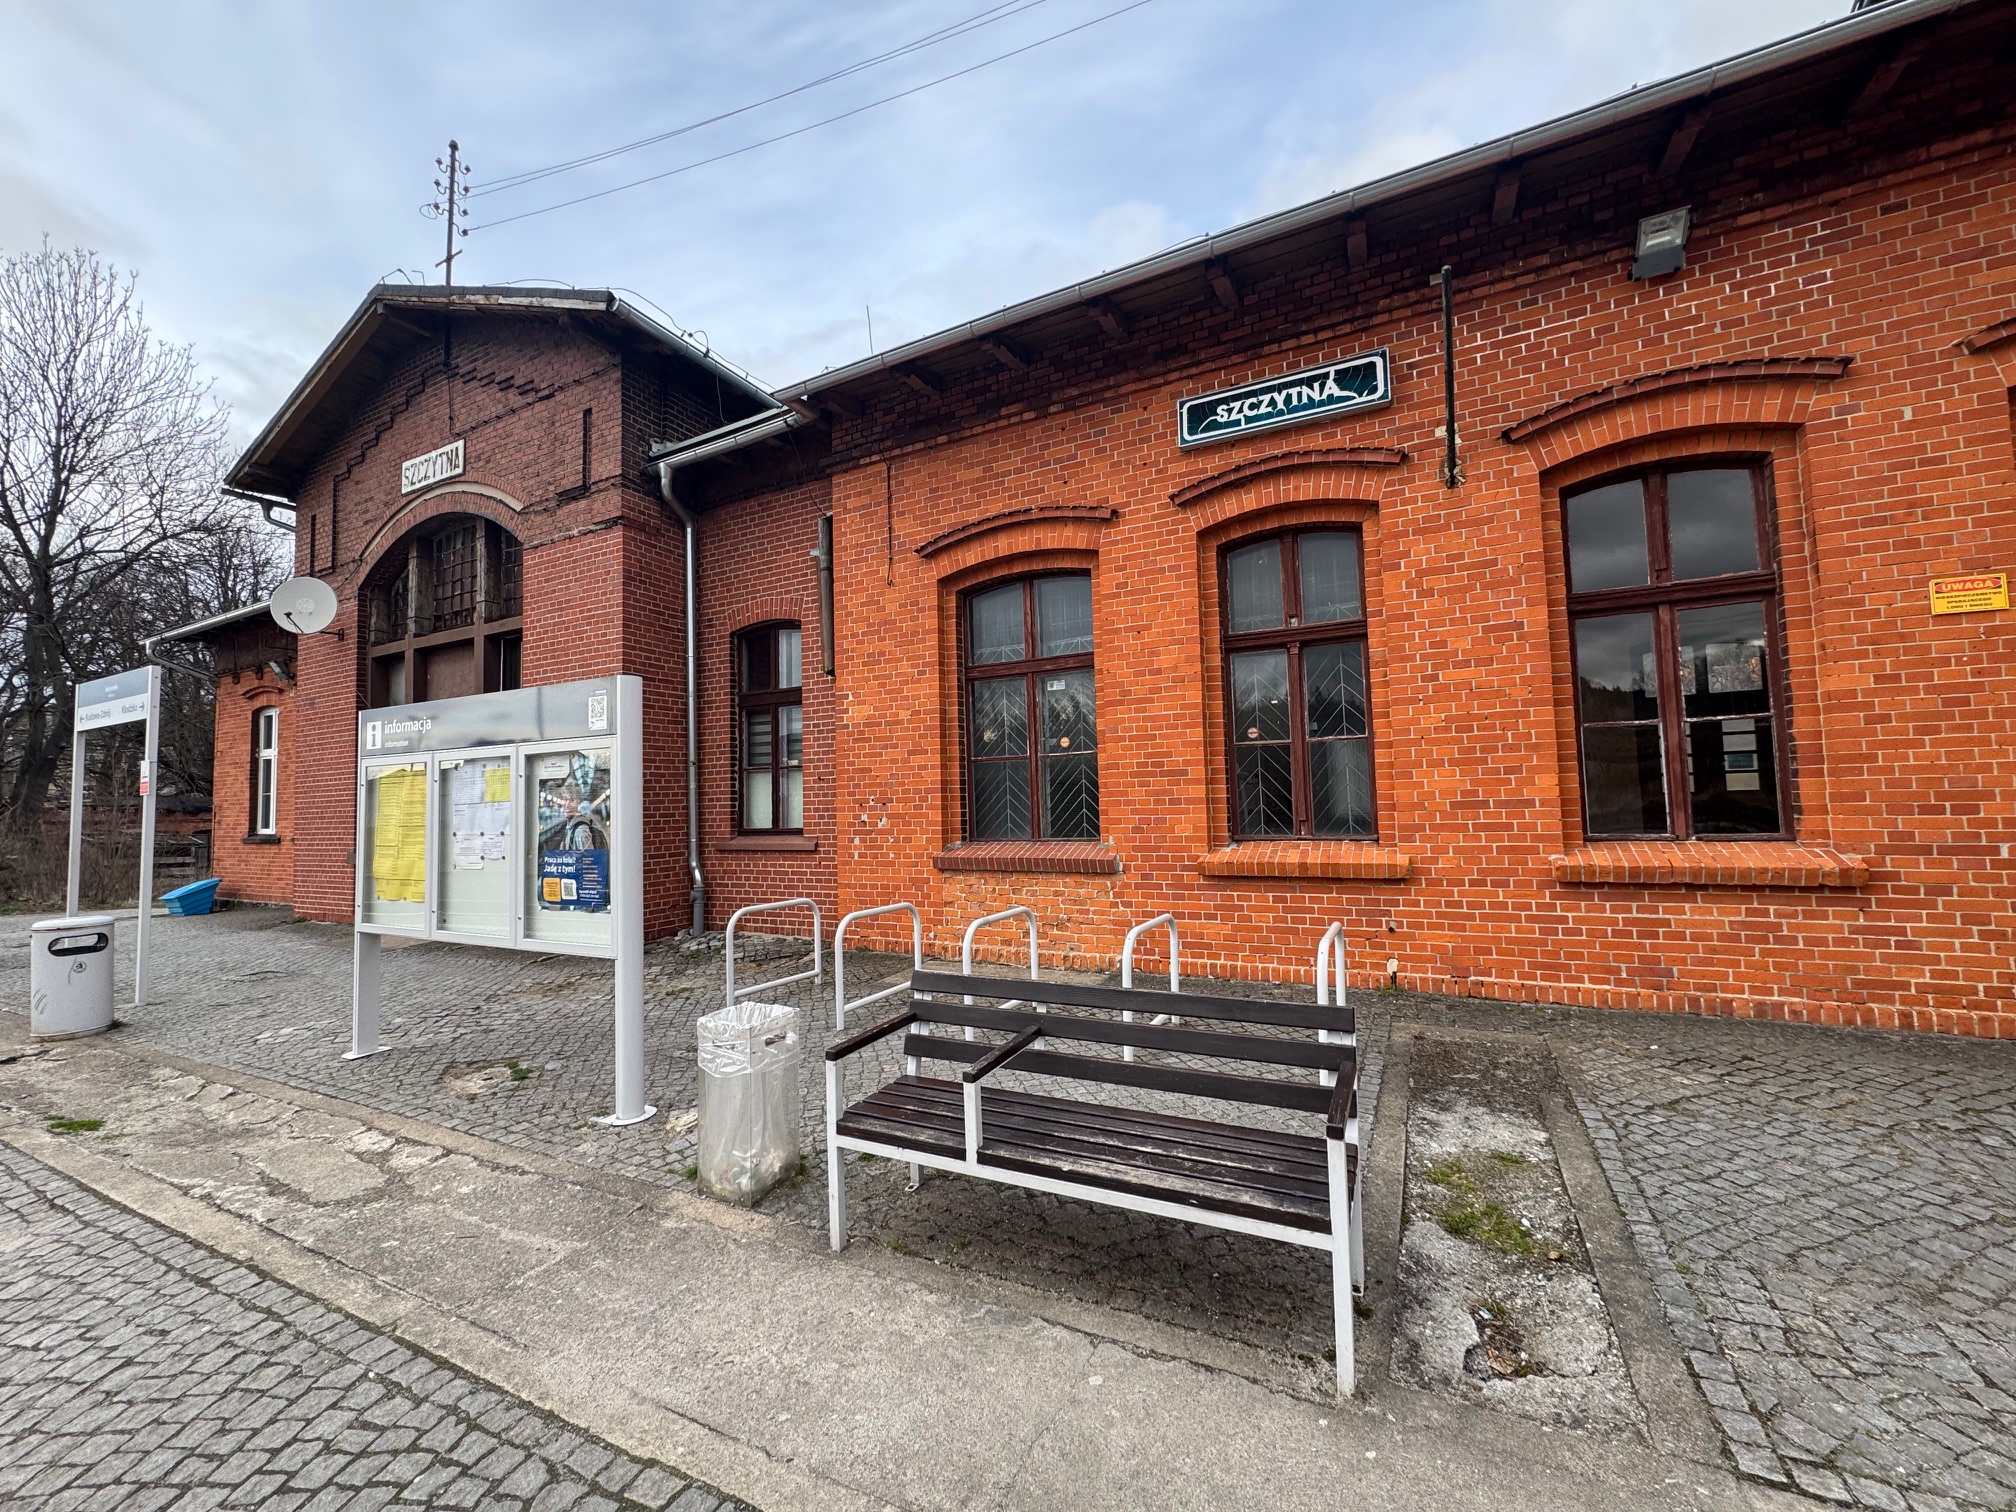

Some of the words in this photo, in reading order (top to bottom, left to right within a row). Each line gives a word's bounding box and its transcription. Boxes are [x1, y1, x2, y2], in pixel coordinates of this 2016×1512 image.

[1216, 379, 1340, 423] SZCZYTNA
[403, 446, 460, 489] SZCZYTNA
[1941, 580, 1995, 591] UWAGA
[384, 716, 432, 734] informacja
[562, 865, 576, 875] tym!
